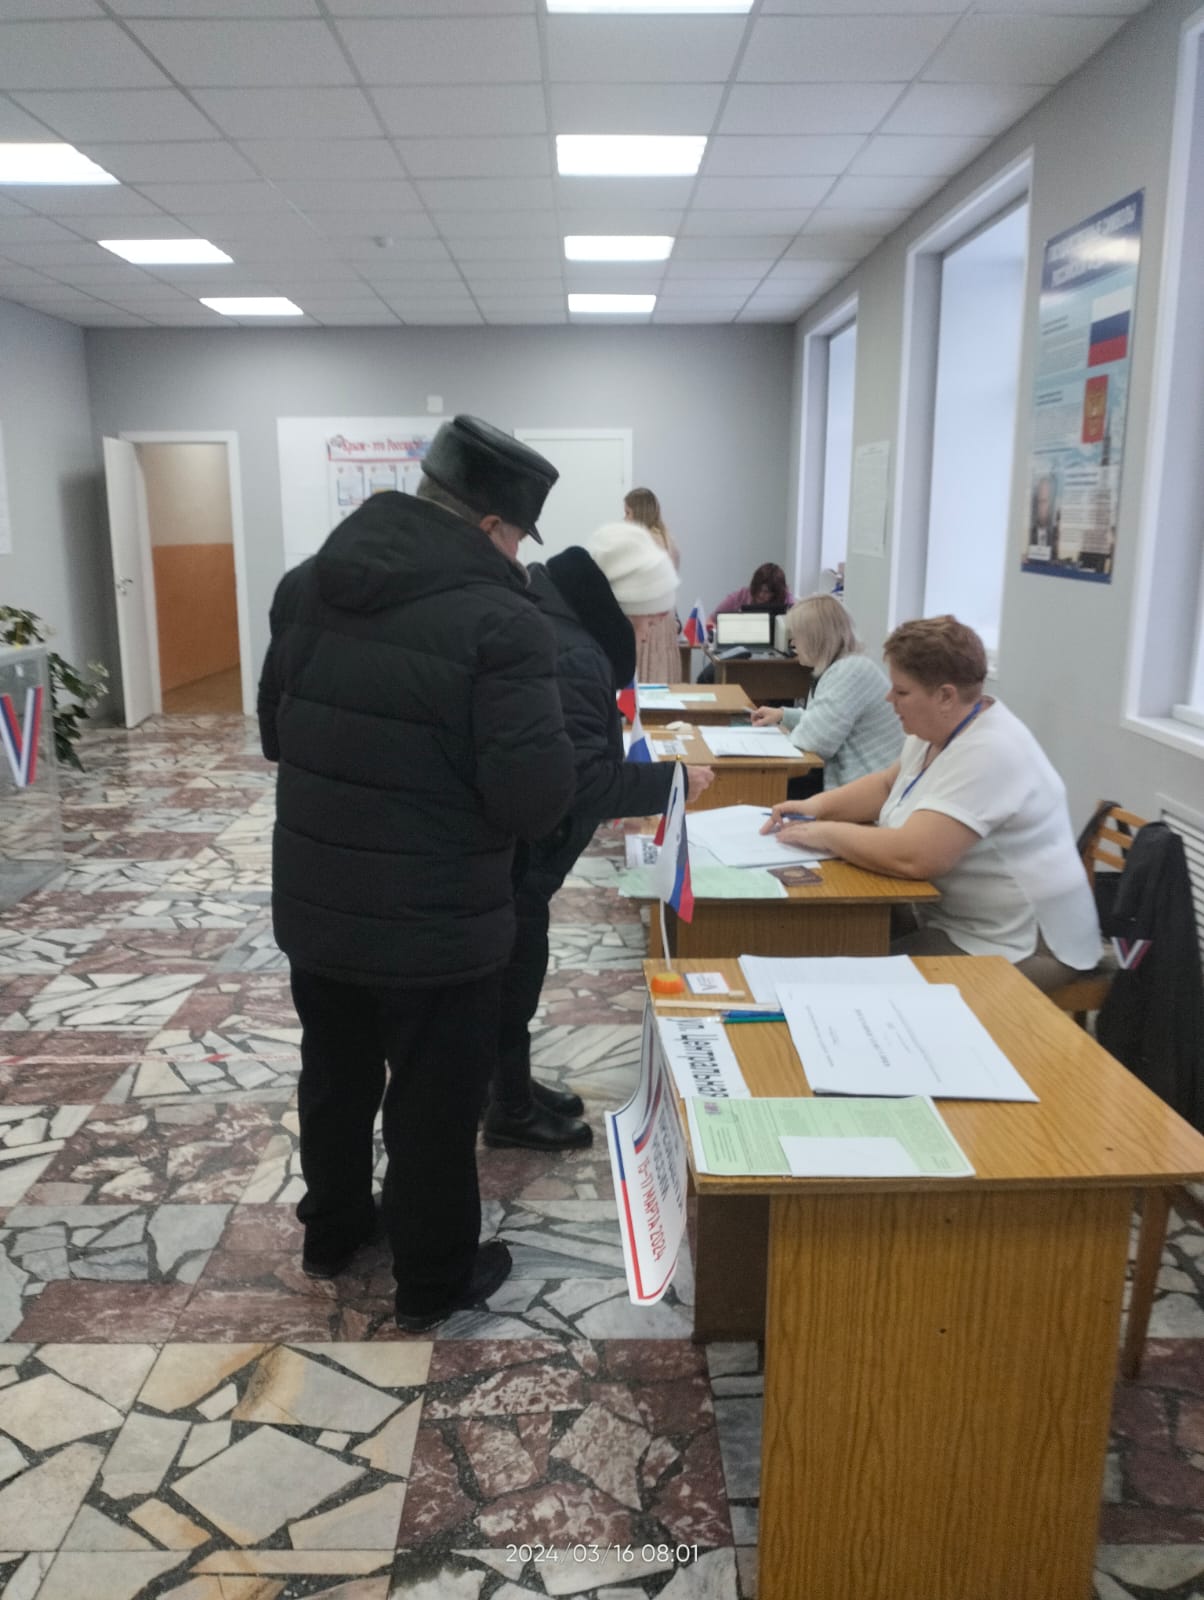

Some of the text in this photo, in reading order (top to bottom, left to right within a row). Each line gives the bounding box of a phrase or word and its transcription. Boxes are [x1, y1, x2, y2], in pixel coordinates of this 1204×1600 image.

[673, 1034, 729, 1098] Центральная
[643, 1187, 661, 1229] МАРТА
[650, 1225, 667, 1263] 2024
